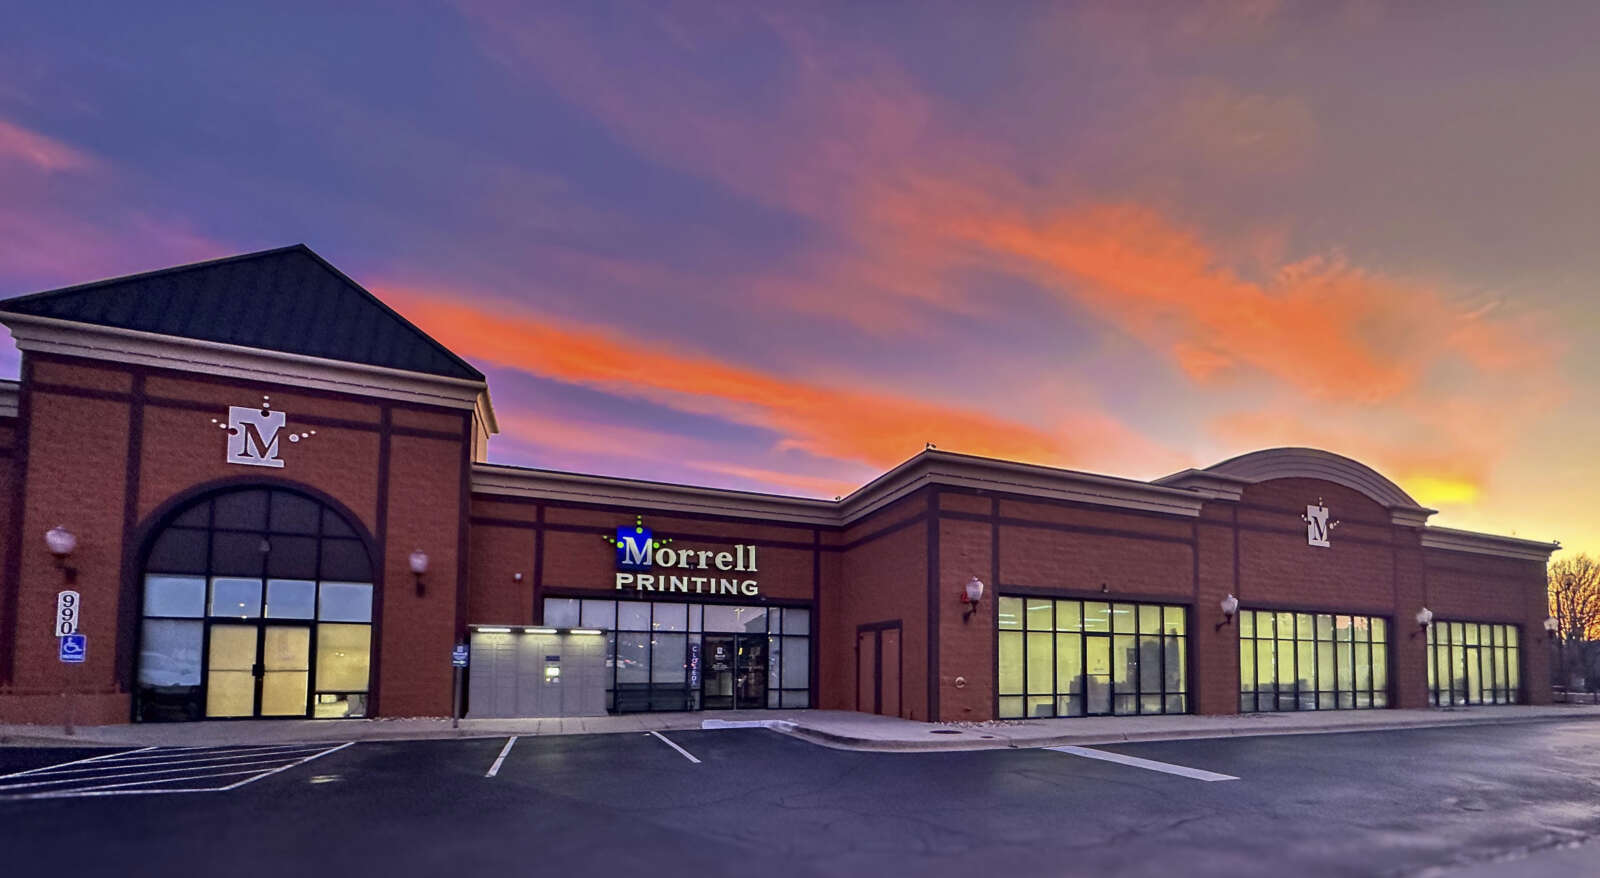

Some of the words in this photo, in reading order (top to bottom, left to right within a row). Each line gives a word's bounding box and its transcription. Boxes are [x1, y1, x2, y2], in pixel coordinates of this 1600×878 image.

[238, 421, 282, 459] M
[1311, 515, 1328, 541] M
[621, 536, 758, 572] Morrell
[615, 572, 759, 596] PRINTING
[61, 594, 75, 635] 990
